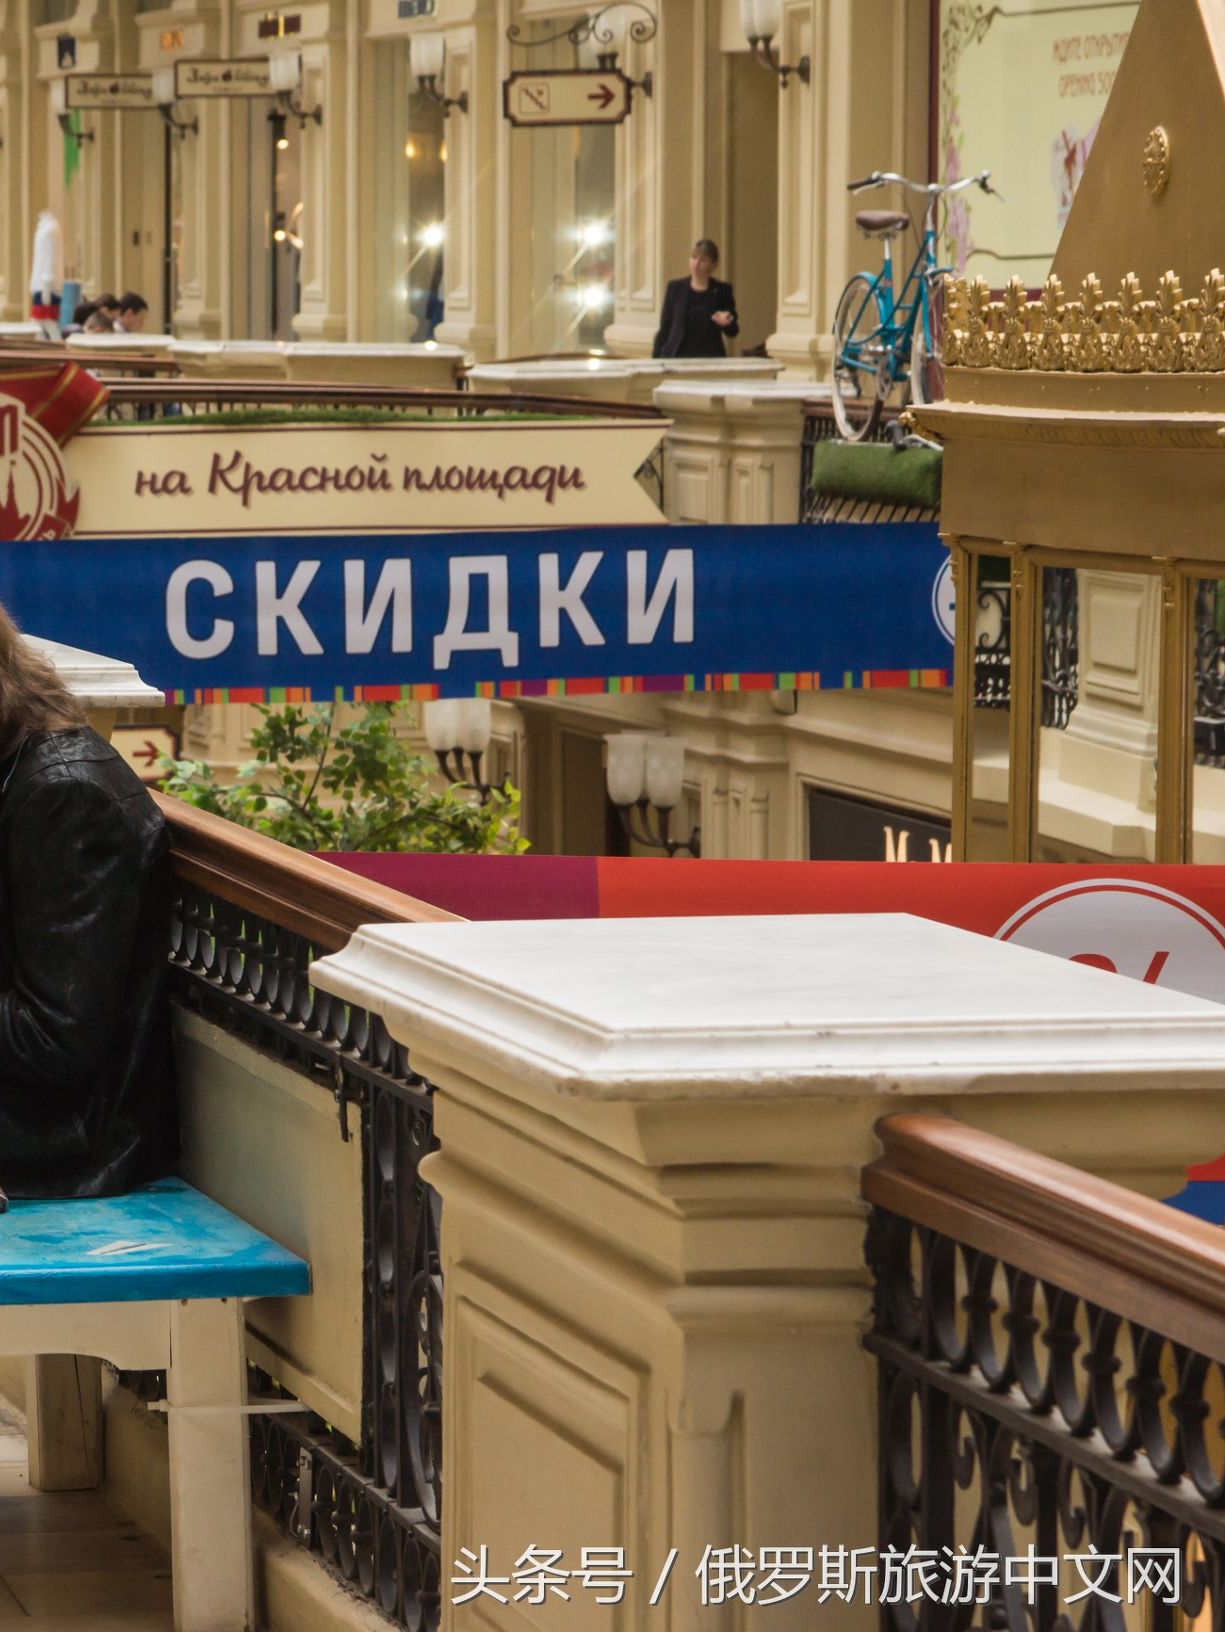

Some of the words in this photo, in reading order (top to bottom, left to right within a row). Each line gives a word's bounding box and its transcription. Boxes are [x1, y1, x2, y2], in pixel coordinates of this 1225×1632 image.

[1085, 31, 1131, 59] ОТКРЫТИ
[135, 470, 192, 496] на
[208, 449, 392, 508] Красной
[402, 464, 585, 504] площади
[165, 548, 694, 670] СКИДКИ
